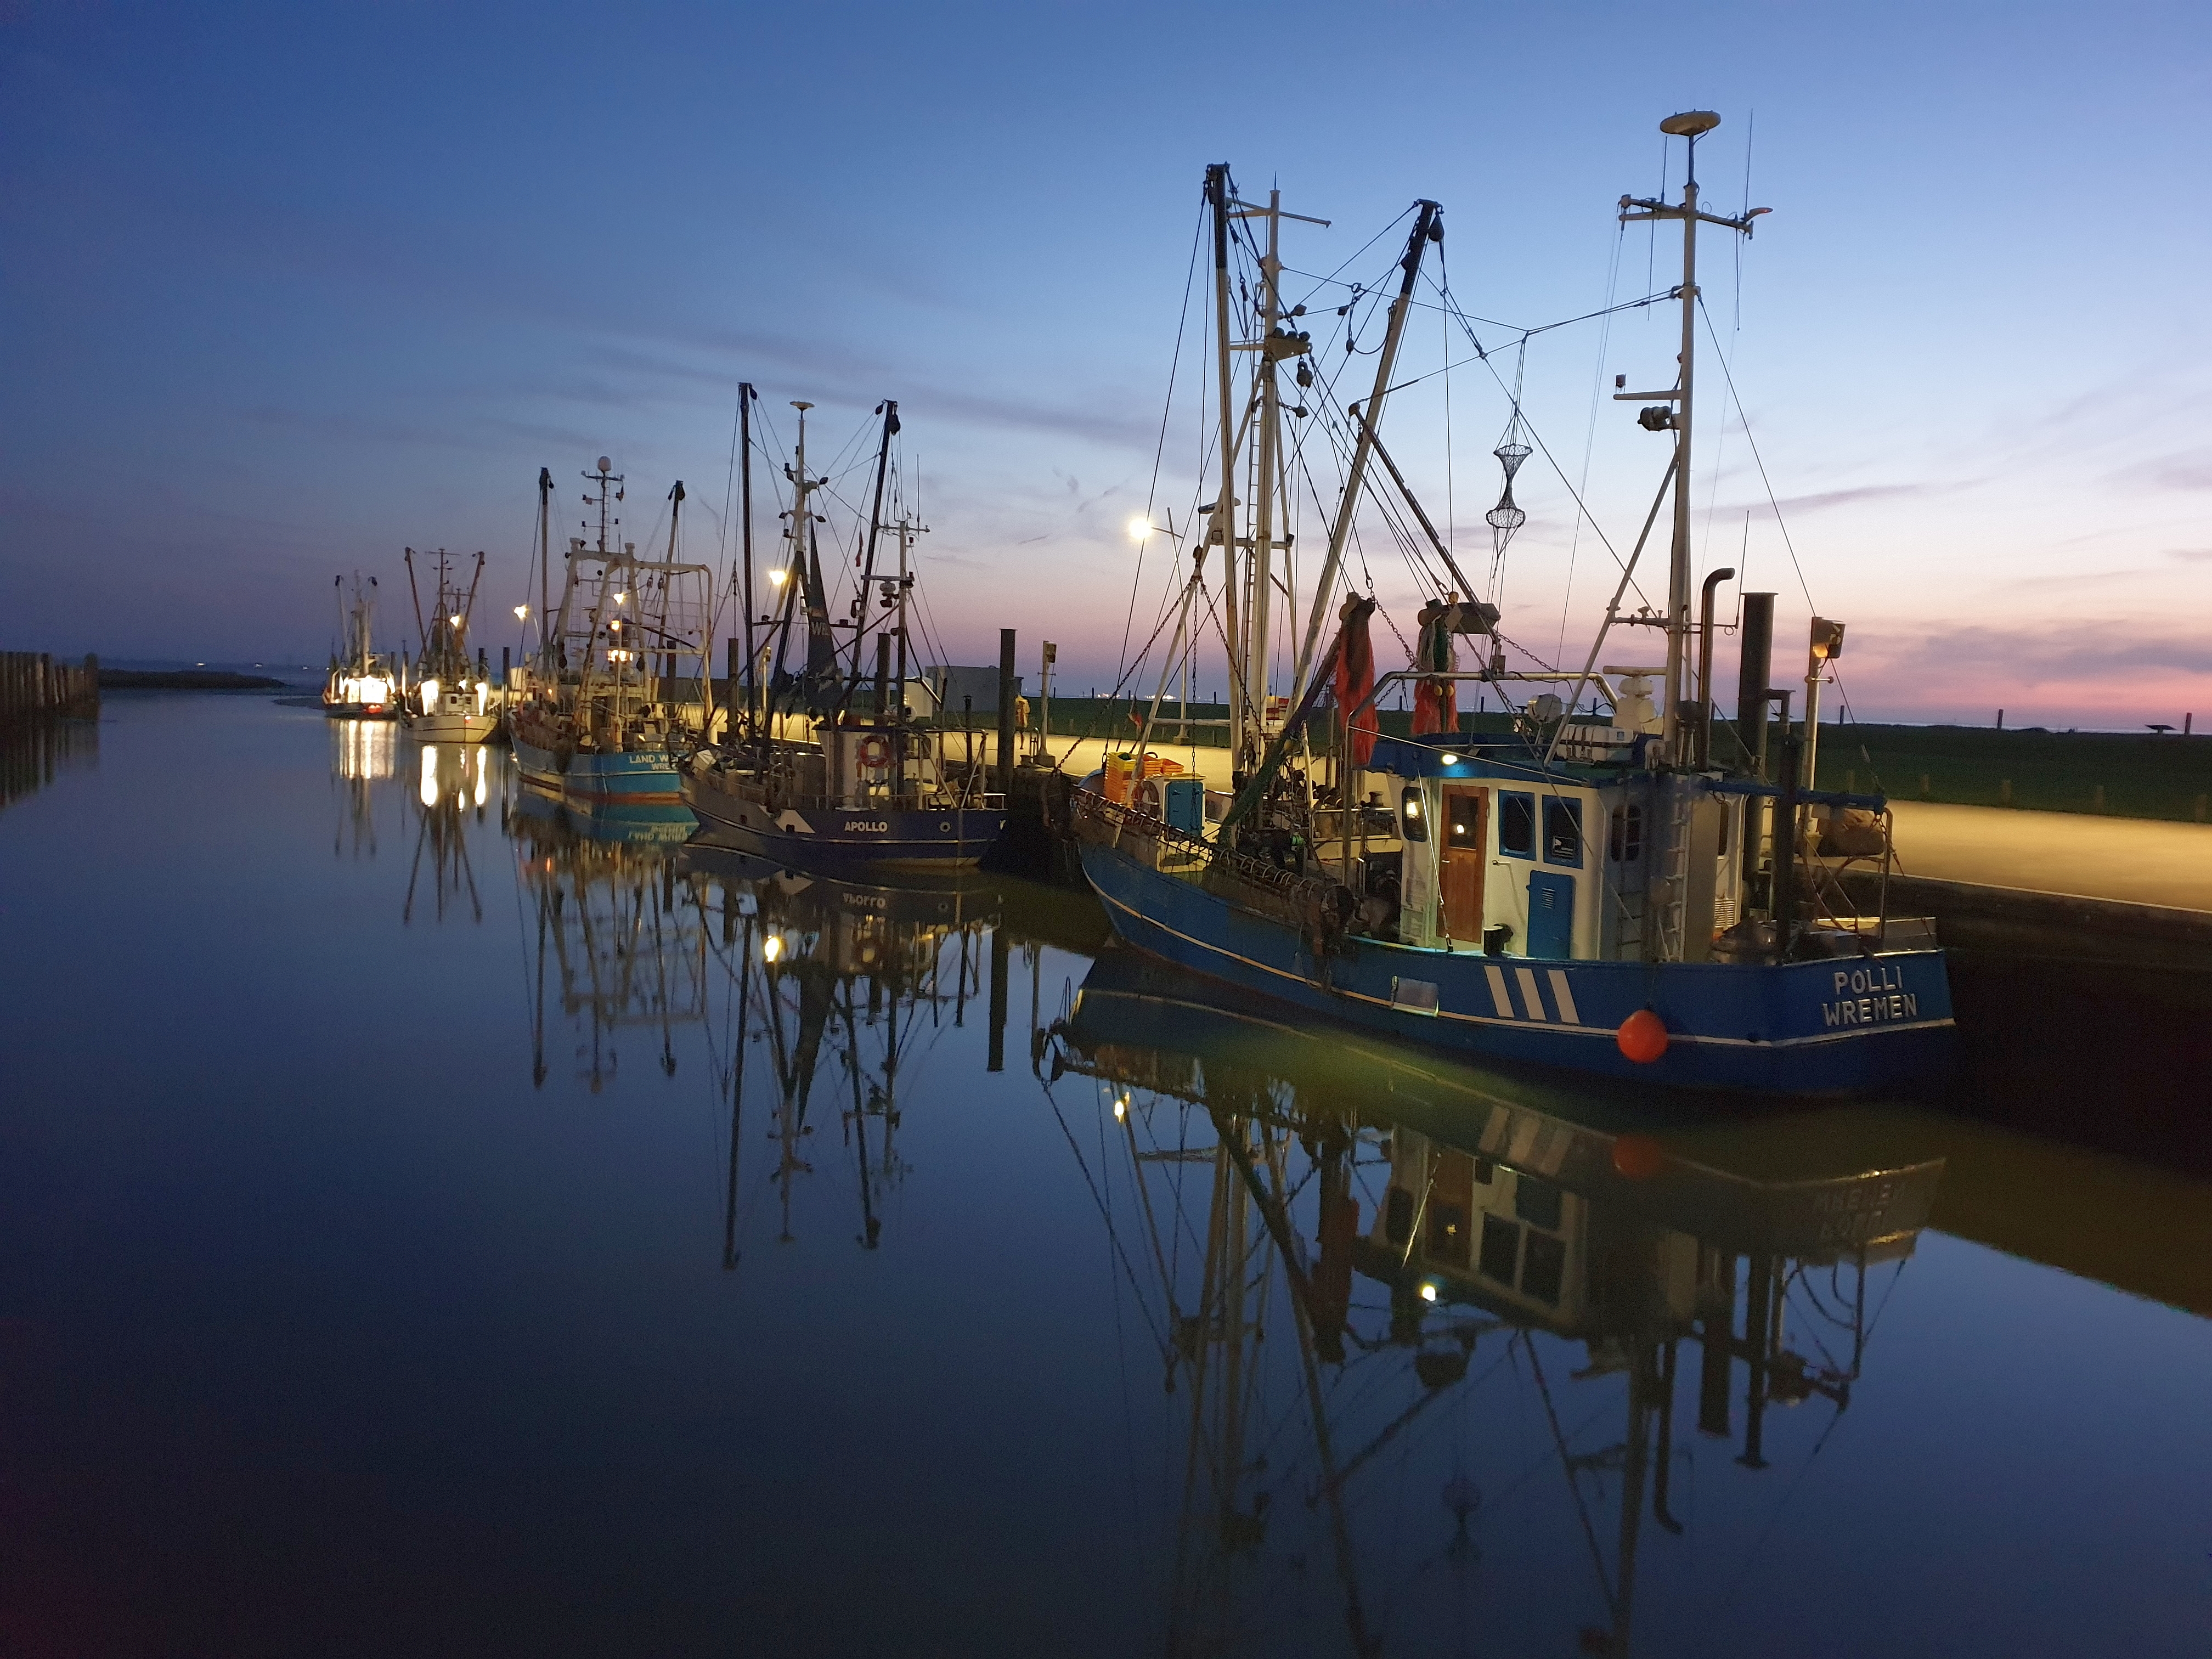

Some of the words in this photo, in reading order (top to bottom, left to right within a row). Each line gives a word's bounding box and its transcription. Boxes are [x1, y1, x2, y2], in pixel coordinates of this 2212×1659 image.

[629, 754, 655, 764] LAND
[844, 821, 888, 832] APOLLO
[1834, 966, 1903, 995] POLLI
[1822, 994, 1917, 1026] WREMEN
